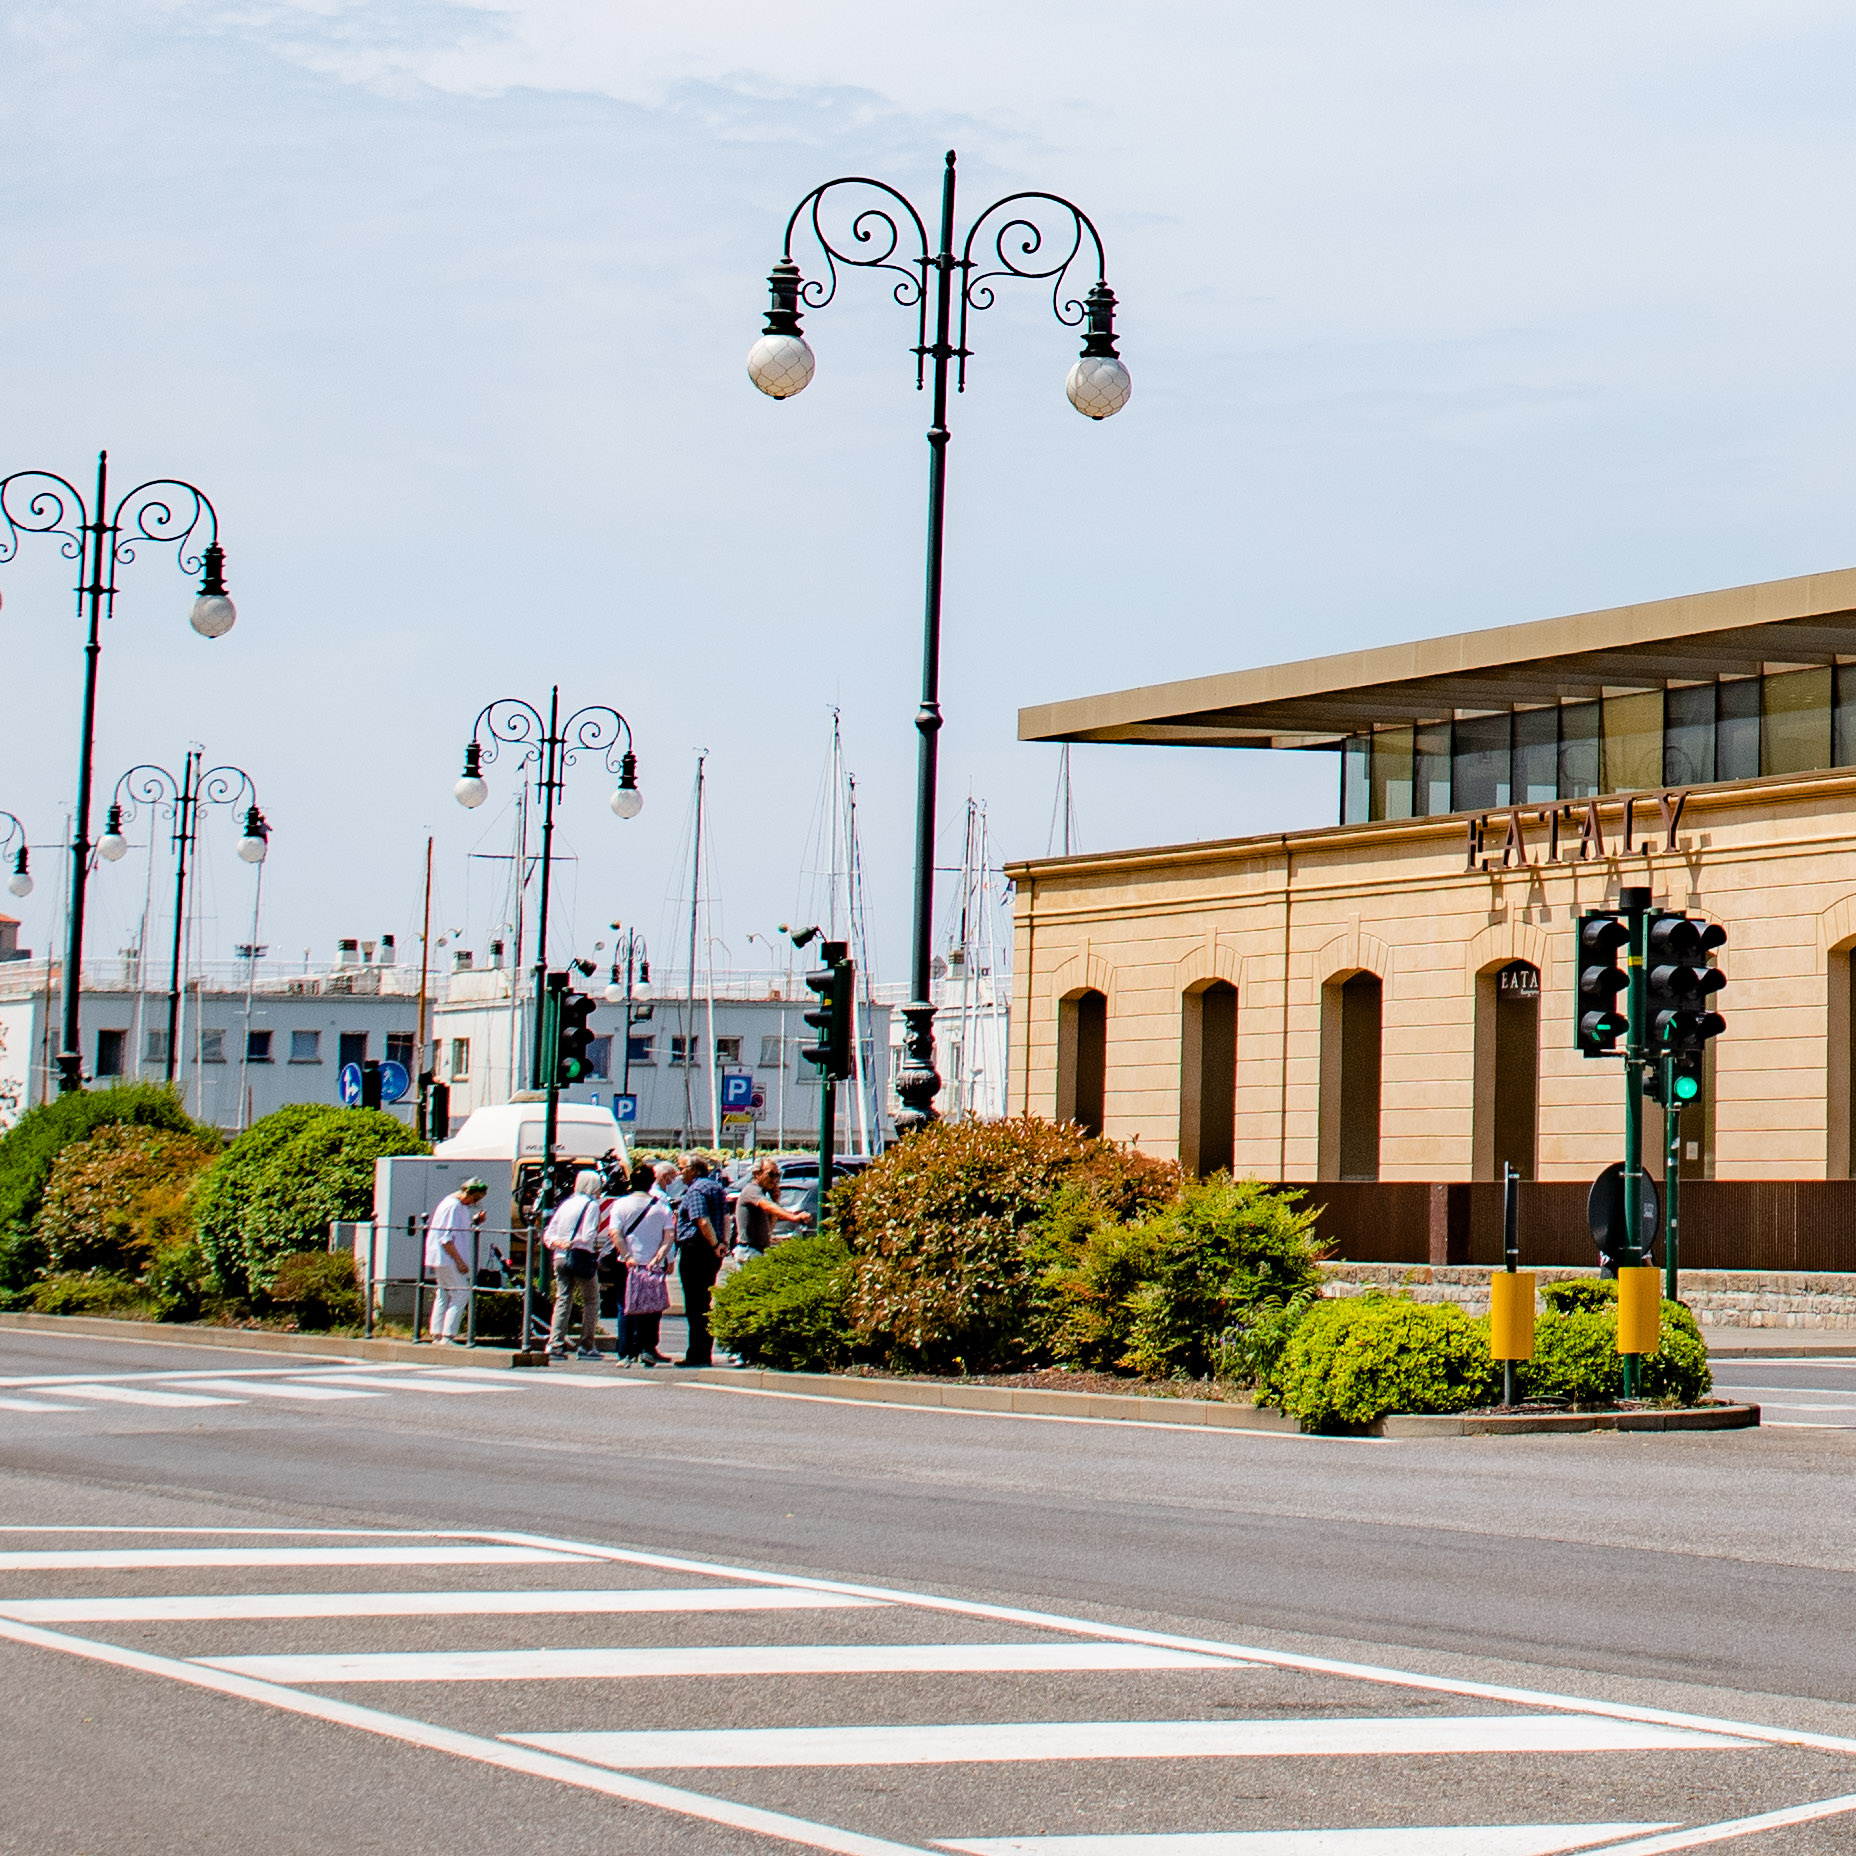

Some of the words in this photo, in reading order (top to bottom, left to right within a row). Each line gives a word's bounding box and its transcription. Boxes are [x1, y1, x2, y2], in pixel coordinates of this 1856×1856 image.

[1464, 789, 1692, 874] EATALY
[728, 1079, 748, 1102] P
[617, 1099, 634, 1119] P
